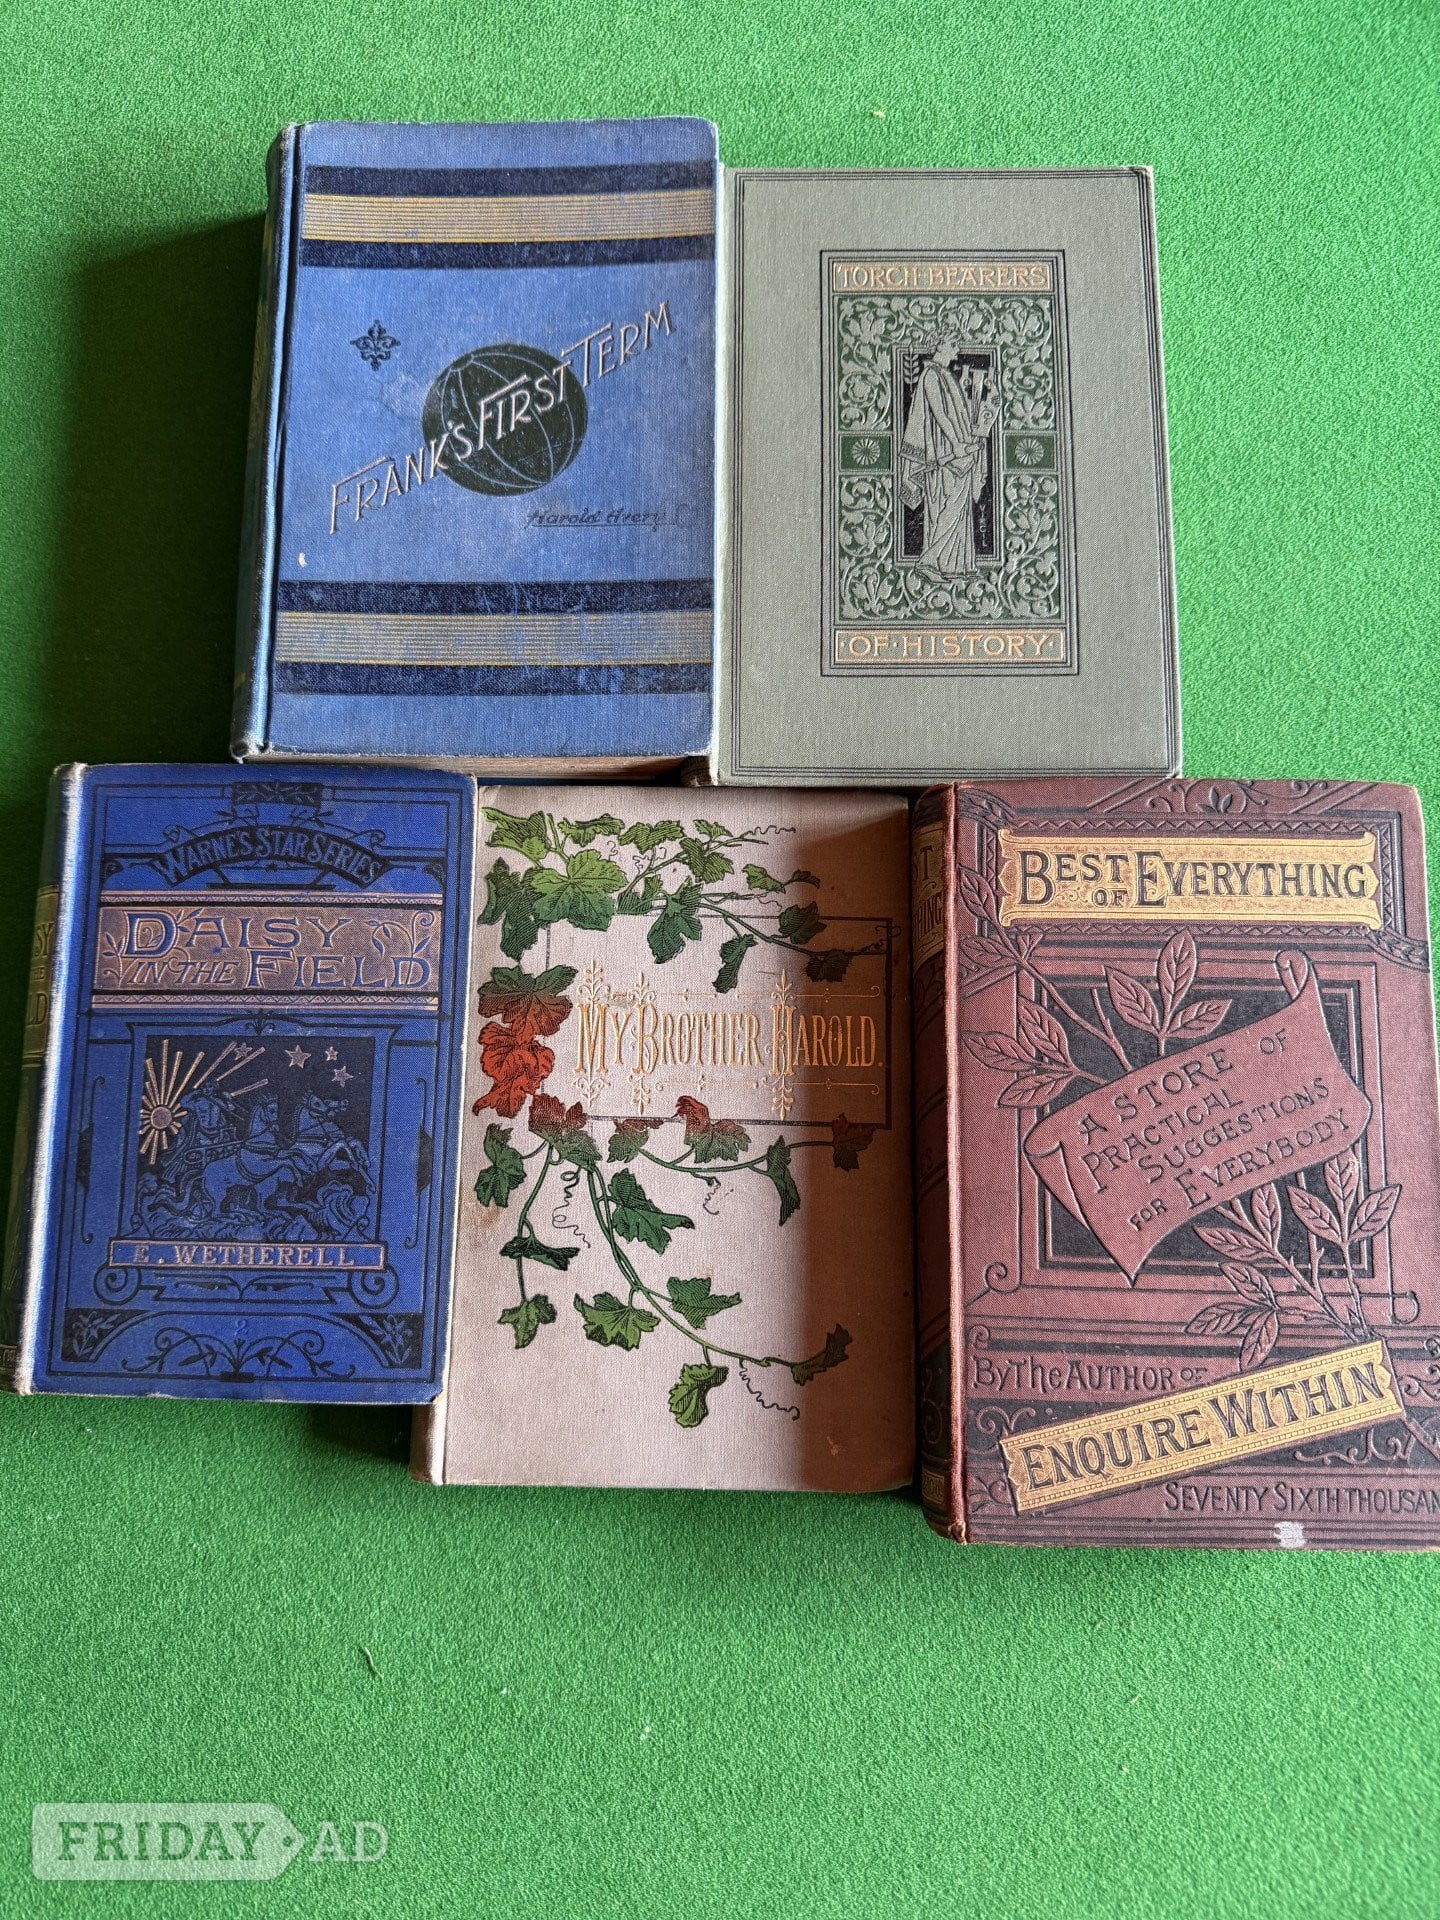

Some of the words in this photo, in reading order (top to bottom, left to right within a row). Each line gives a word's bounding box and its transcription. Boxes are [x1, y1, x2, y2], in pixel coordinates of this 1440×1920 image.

[329, 421, 474, 536] FRANK'S
[477, 361, 573, 451] FIRST
[561, 300, 676, 388] TERM
[849, 635, 889, 658] OF
[902, 634, 1049, 658] HISTORY
[152, 830, 251, 883] WARNE'S
[255, 827, 308, 858] STAR
[306, 832, 383, 884] SERIES
[1017, 849, 1129, 906] BEST
[1092, 887, 1128, 908] OF
[1133, 849, 1369, 908] EVERYTHING
[123, 909, 353, 958] DAISY
[126, 961, 166, 985] IN
[178, 961, 239, 985] THE
[245, 948, 433, 990] FIELD
[573, 1003, 632, 1075] MY
[632, 1002, 764, 1075] BROTHER
[770, 1003, 884, 1077] HAROLD.
[1078, 1113, 1107, 1145] A
[1112, 1048, 1233, 1124] STORE
[1258, 1028, 1289, 1056] OF
[1080, 1088, 1244, 1193] PRACTICAL
[1136, 1077, 1330, 1183] SUGGESTIONS
[1128, 1199, 1167, 1232] FOR
[1173, 1107, 1351, 1211] EVERYBODY
[174, 1244, 355, 1266] WETHERELL
[1063, 1359, 1175, 1391] AUTHOR
[1179, 1366, 1208, 1383] OF
[1025, 1409, 1211, 1490] ENQUIRE
[1207, 1361, 1385, 1440] WITHIN
[1164, 1481, 1269, 1512] SEVENTY
[1272, 1480, 1339, 1513] SIXTH
